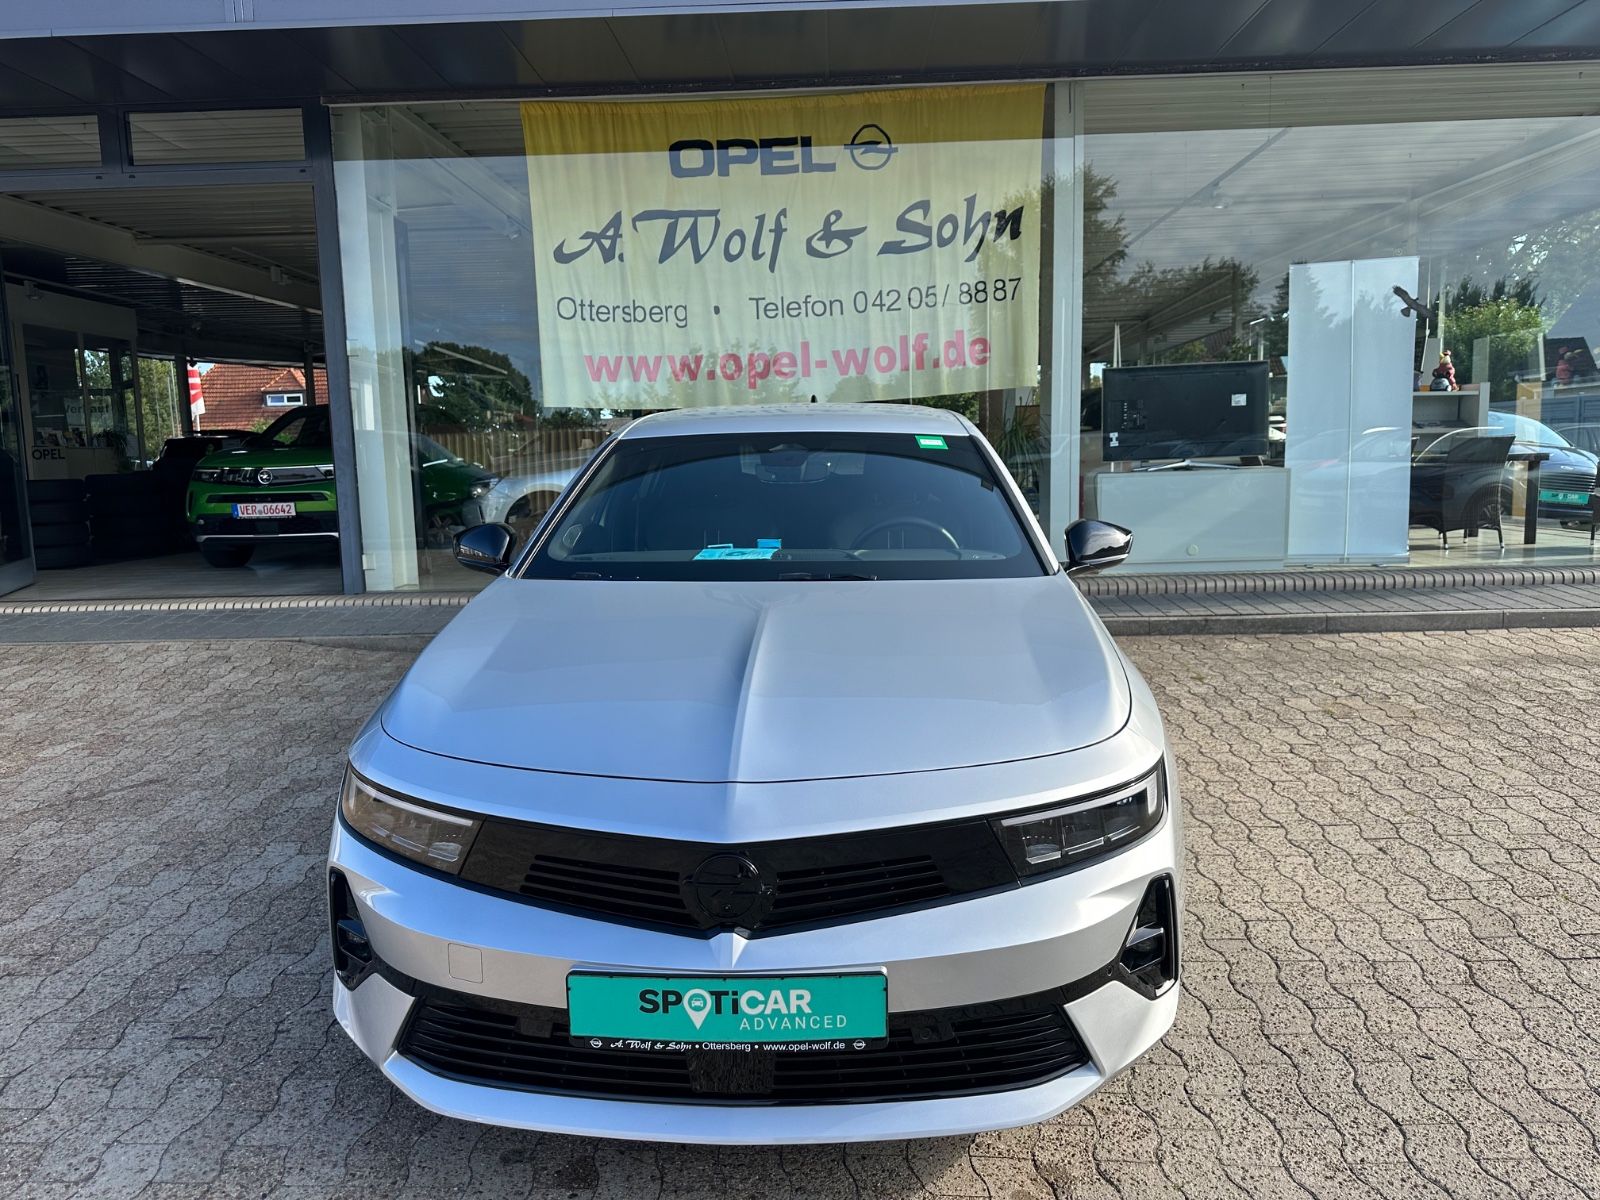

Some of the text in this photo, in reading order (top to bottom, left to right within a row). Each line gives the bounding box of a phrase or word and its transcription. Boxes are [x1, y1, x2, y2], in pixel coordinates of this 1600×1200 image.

[668, 135, 837, 178] OPEL
[553, 193, 1024, 273] A. Wolf & Sohn
[556, 296, 688, 328] Ottersberg
[748, 294, 844, 320] Telefon
[584, 329, 991, 389] www.opel-wolf.de
[32, 448, 65, 460] OPEL
[739, 1014, 847, 1031] ADVANCED
[610, 1039, 846, 1053] A. Wolf & Sohn Ottersberg www.opel-wolf.de
